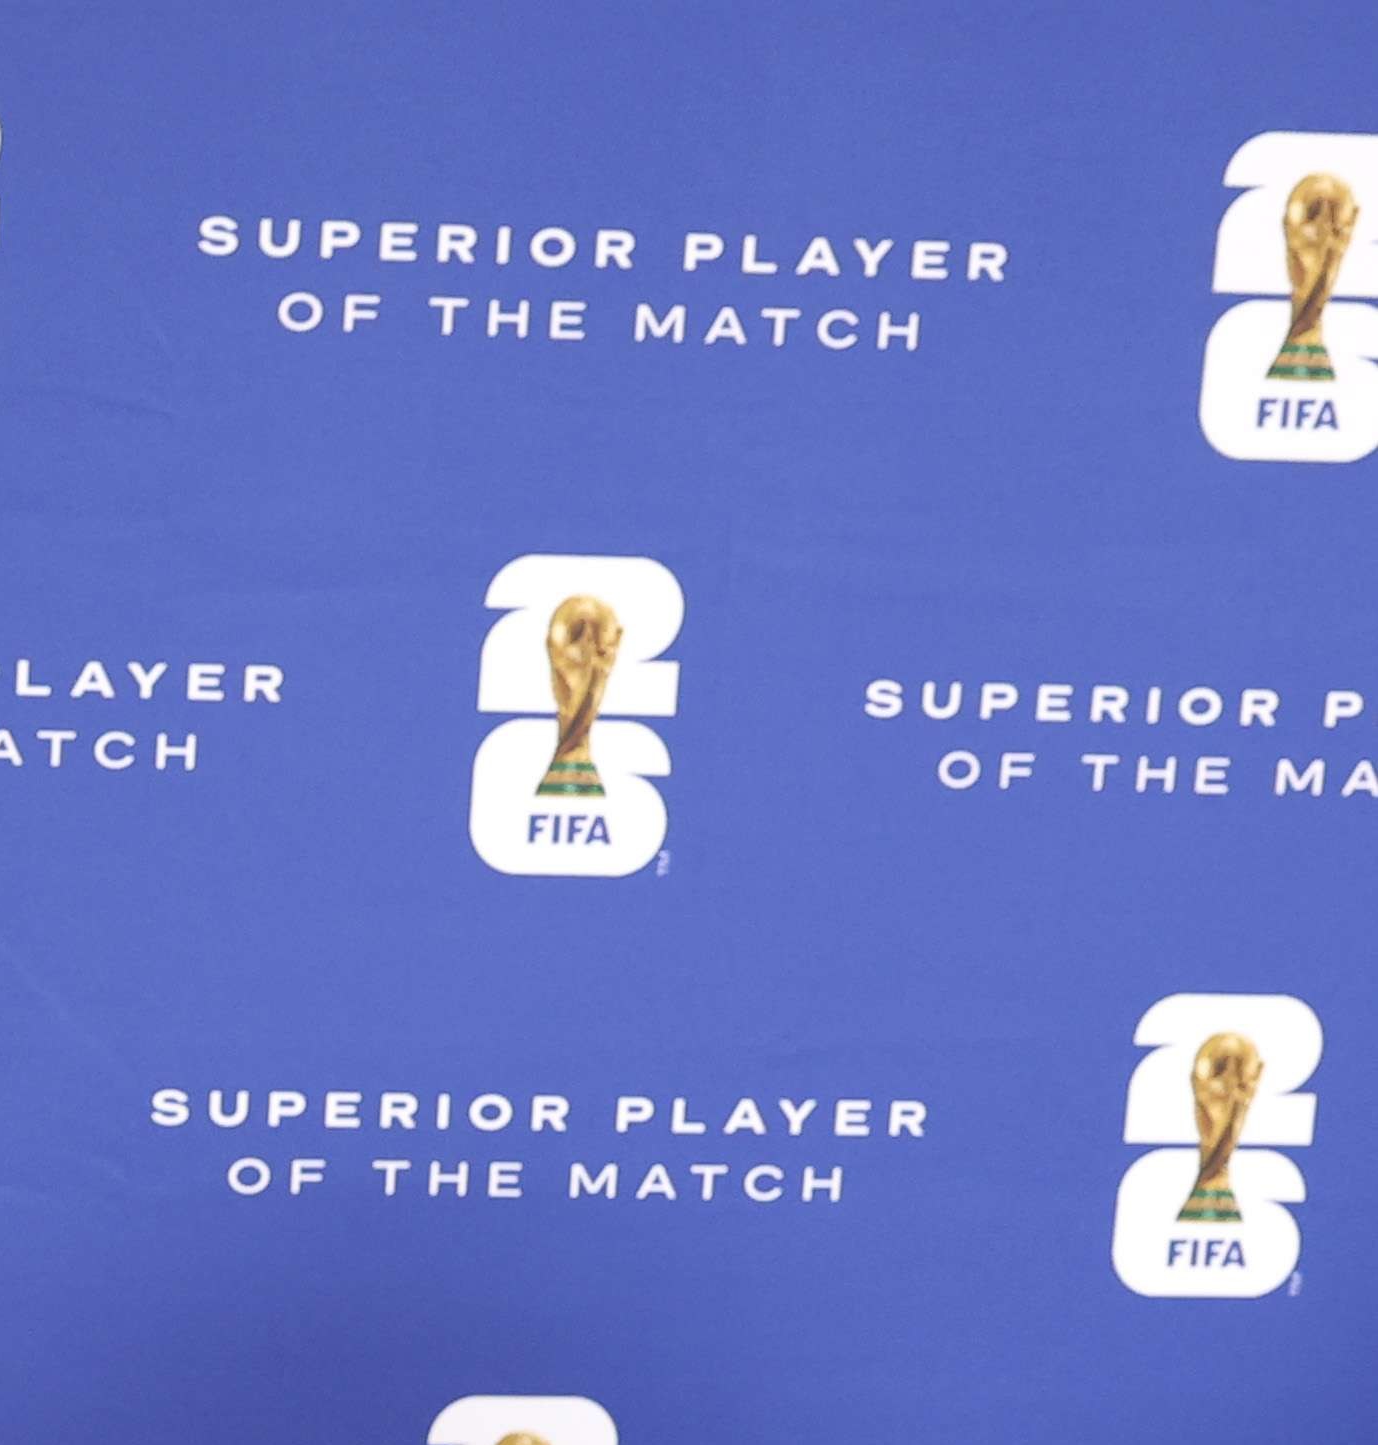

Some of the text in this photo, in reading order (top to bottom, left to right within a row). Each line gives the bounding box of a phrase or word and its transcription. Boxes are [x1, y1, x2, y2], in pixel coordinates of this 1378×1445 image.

[197, 215, 1008, 283] SUPERIOR PLAYER
[277, 291, 920, 352] OF THE MATCH
[1257, 398, 1338, 430] FIFA
[864, 679, 1280, 728] SUPERIOR
[937, 750, 1037, 790] OF
[1081, 753, 1231, 795] THE
[528, 814, 611, 845] FIFA
[150, 1088, 927, 1138] SUPERIOR PLAYER
[227, 1157, 843, 1203] OF THE MATCH
[1167, 1239, 1245, 1267] FIFA
